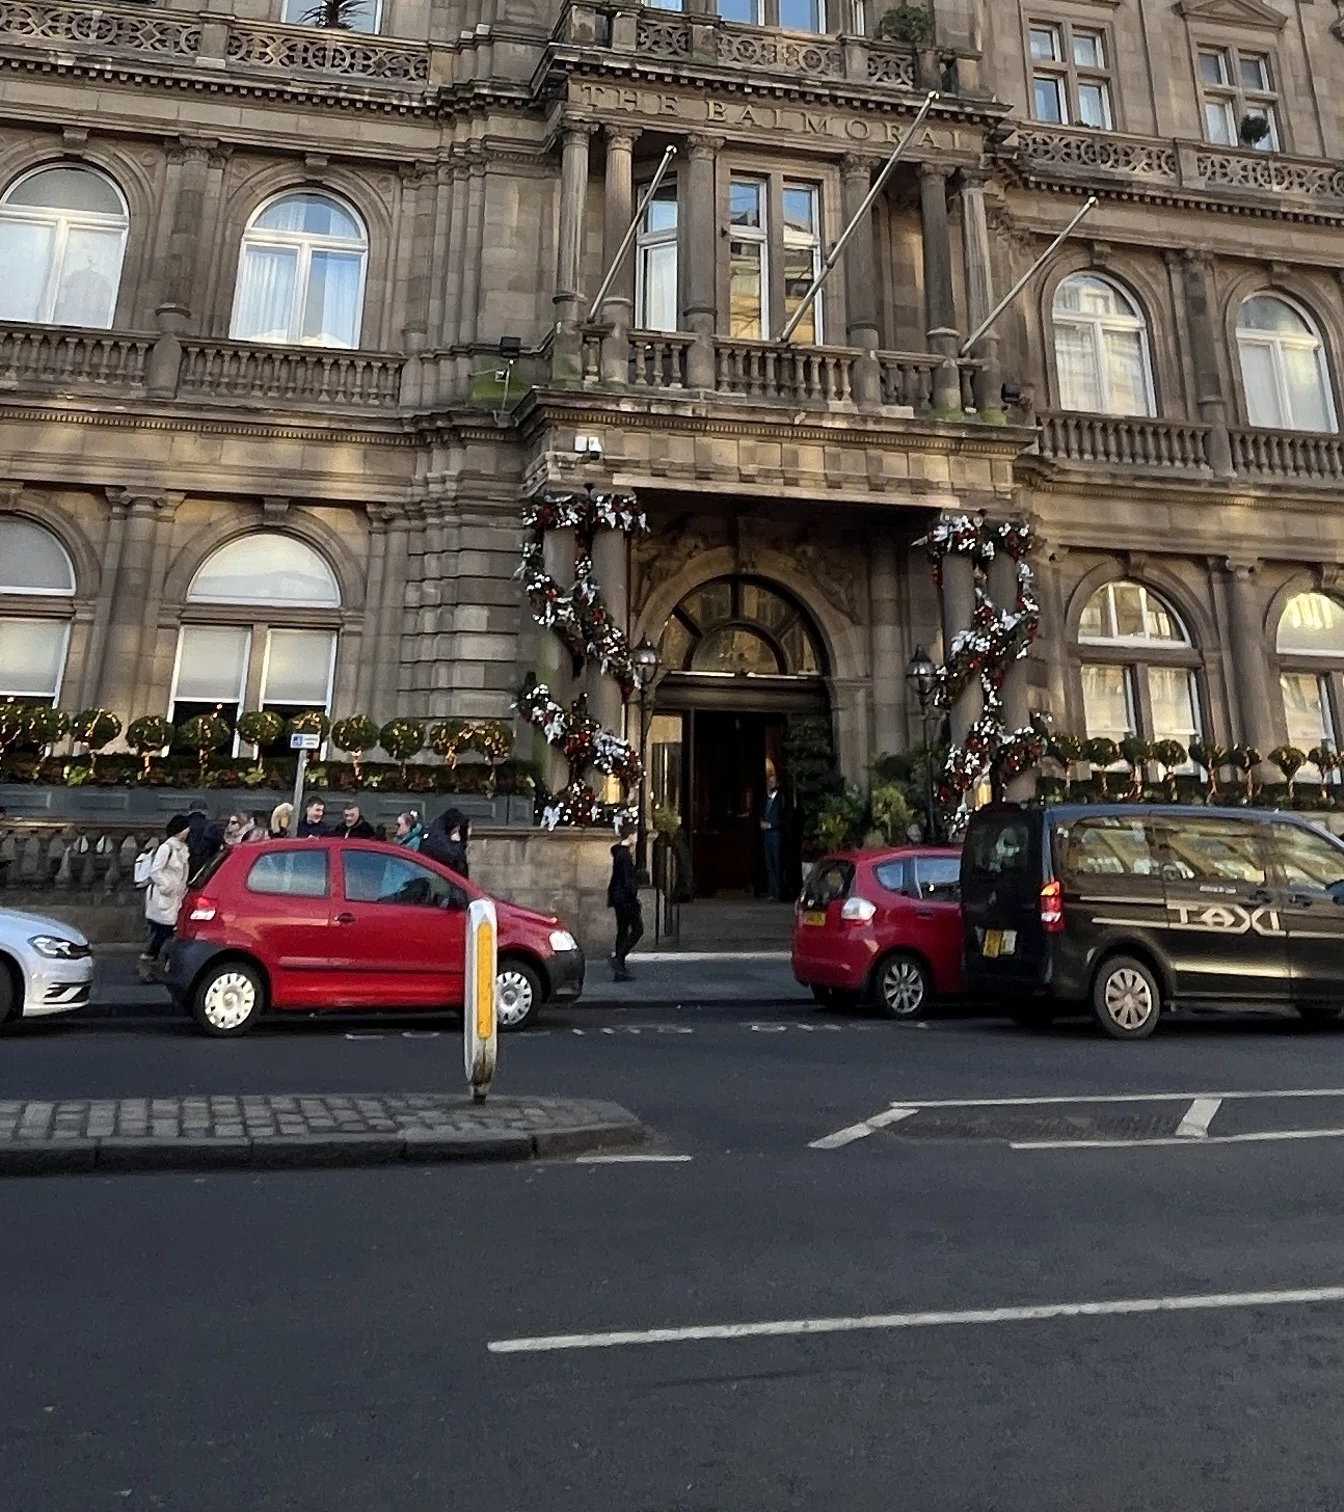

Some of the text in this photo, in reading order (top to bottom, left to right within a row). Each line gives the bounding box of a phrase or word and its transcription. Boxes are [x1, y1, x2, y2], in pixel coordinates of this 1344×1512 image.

[581, 85, 971, 152] THE BALMORAL
[1166, 900, 1287, 937] TAXI
